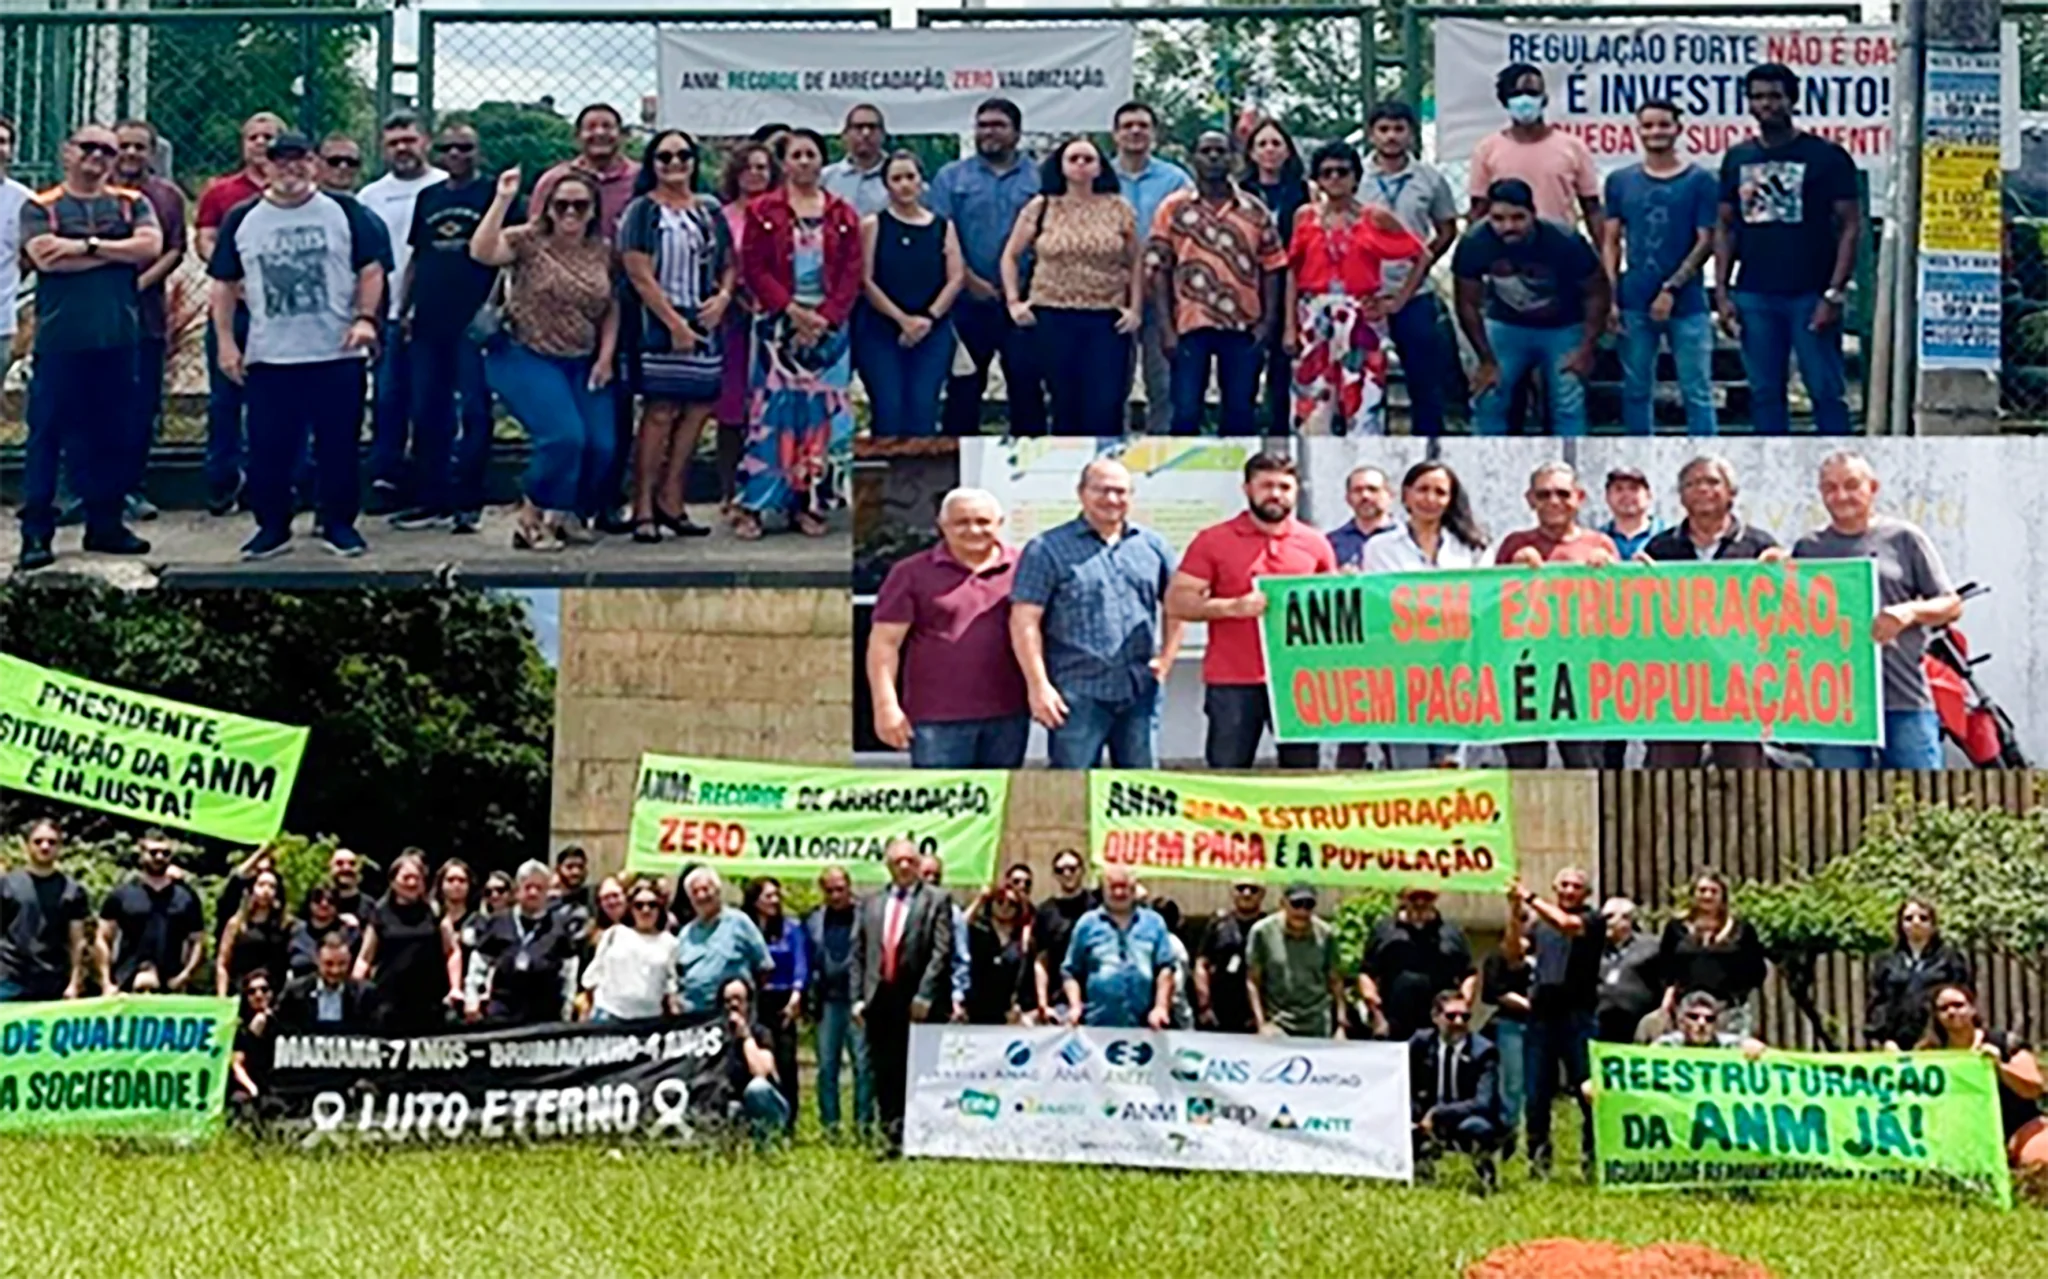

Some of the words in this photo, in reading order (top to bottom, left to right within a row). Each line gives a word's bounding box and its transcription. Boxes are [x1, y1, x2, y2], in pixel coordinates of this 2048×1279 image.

[1509, 30, 1665, 67] REGULAÇÃO
[1674, 34, 1759, 65] FORTE
[1767, 29, 1822, 65] NÃO
[1831, 28, 1847, 65] É
[727, 73, 799, 92] RECORDE
[804, 73, 824, 91] DE
[952, 71, 994, 90] ZERO
[1568, 63, 1588, 115] É
[1285, 587, 1365, 647] ANM
[1390, 583, 1472, 643] SEM
[1501, 559, 1852, 652] ESTRUTURAÇÃO,
[37, 681, 223, 752] PRESIDENTE,
[1293, 665, 1396, 726] QUEM
[1406, 663, 1503, 725] PAGA
[1514, 648, 1538, 722] É
[1550, 661, 1577, 721] A
[1588, 649, 1854, 741] POPULAÇÃO!
[0, 713, 124, 772] SITUAÇÃO
[131, 747, 171, 780] DA
[180, 752, 278, 802] ANM
[26, 752, 47, 788] É
[52, 767, 195, 820] INJUSTA!
[698, 780, 788, 809] RECORDE
[796, 786, 825, 812] DE
[1258, 787, 1501, 831] ESTRUTURAÇÃO,
[658, 817, 747, 858] ZERO
[756, 830, 938, 862] VALORIZAO
[1104, 829, 1186, 866] QUEM
[1193, 829, 1266, 868] PAGA
[1274, 833, 1291, 868] É
[1295, 841, 1314, 868] A
[1321, 839, 1493, 877] POPULAÇÃO
[3, 1018, 44, 1056] DE
[51, 1015, 223, 1058] QUALIDADE,
[407, 1038, 469, 1070] ANOS
[662, 1026, 724, 1061] ANOS
[1201, 1058, 1250, 1084] ANS
[1601, 1056, 1946, 1099] REESTRUTURAÇÃO
[357, 1090, 470, 1139] LUTO
[483, 1082, 641, 1140] ETERNO
[1121, 1102, 1178, 1122] ANM
[1622, 1114, 1672, 1150] DA
[1689, 1101, 1830, 1156] ANM
[1843, 1096, 1928, 1158] JÁ!
